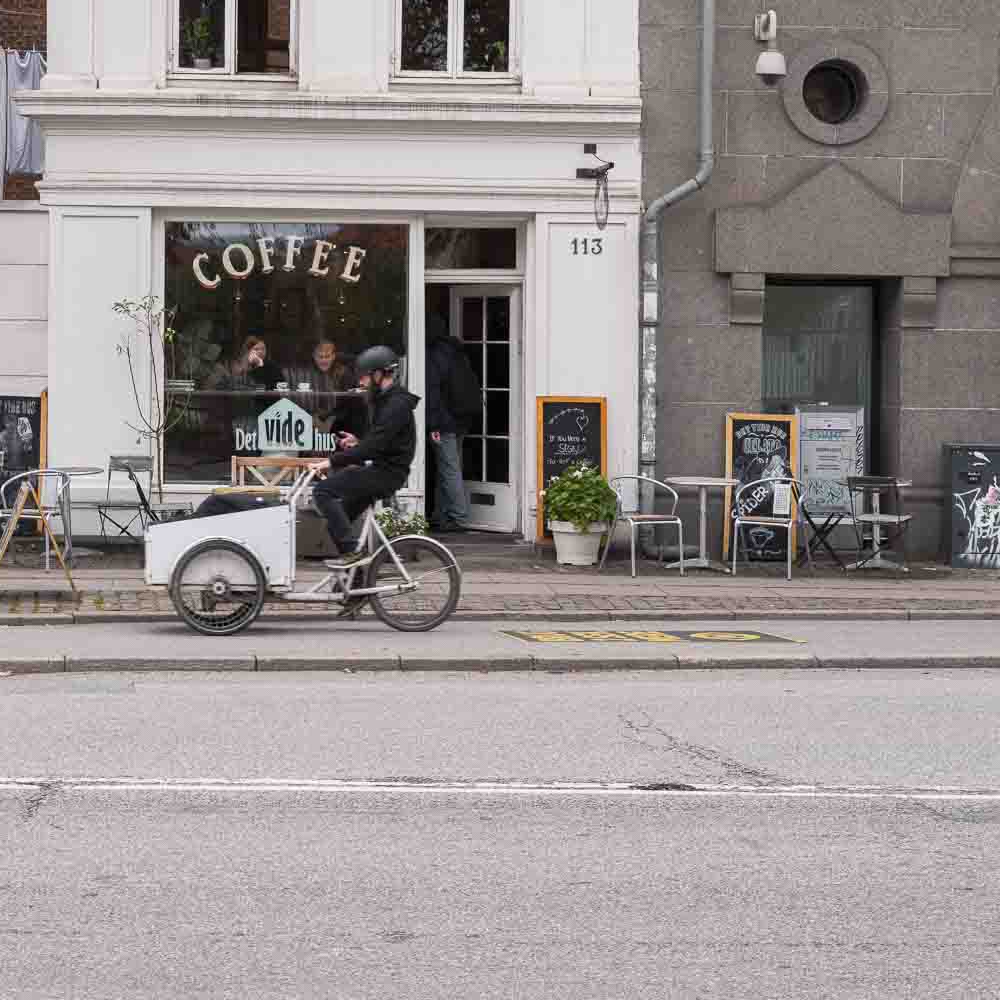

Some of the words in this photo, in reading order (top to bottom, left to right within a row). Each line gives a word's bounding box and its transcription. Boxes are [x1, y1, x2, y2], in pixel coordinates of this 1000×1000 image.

[571, 238, 602, 255] 113
[193, 236, 366, 288] COFFEE
[235, 428, 257, 451] Det
[314, 427, 337, 452] hus
